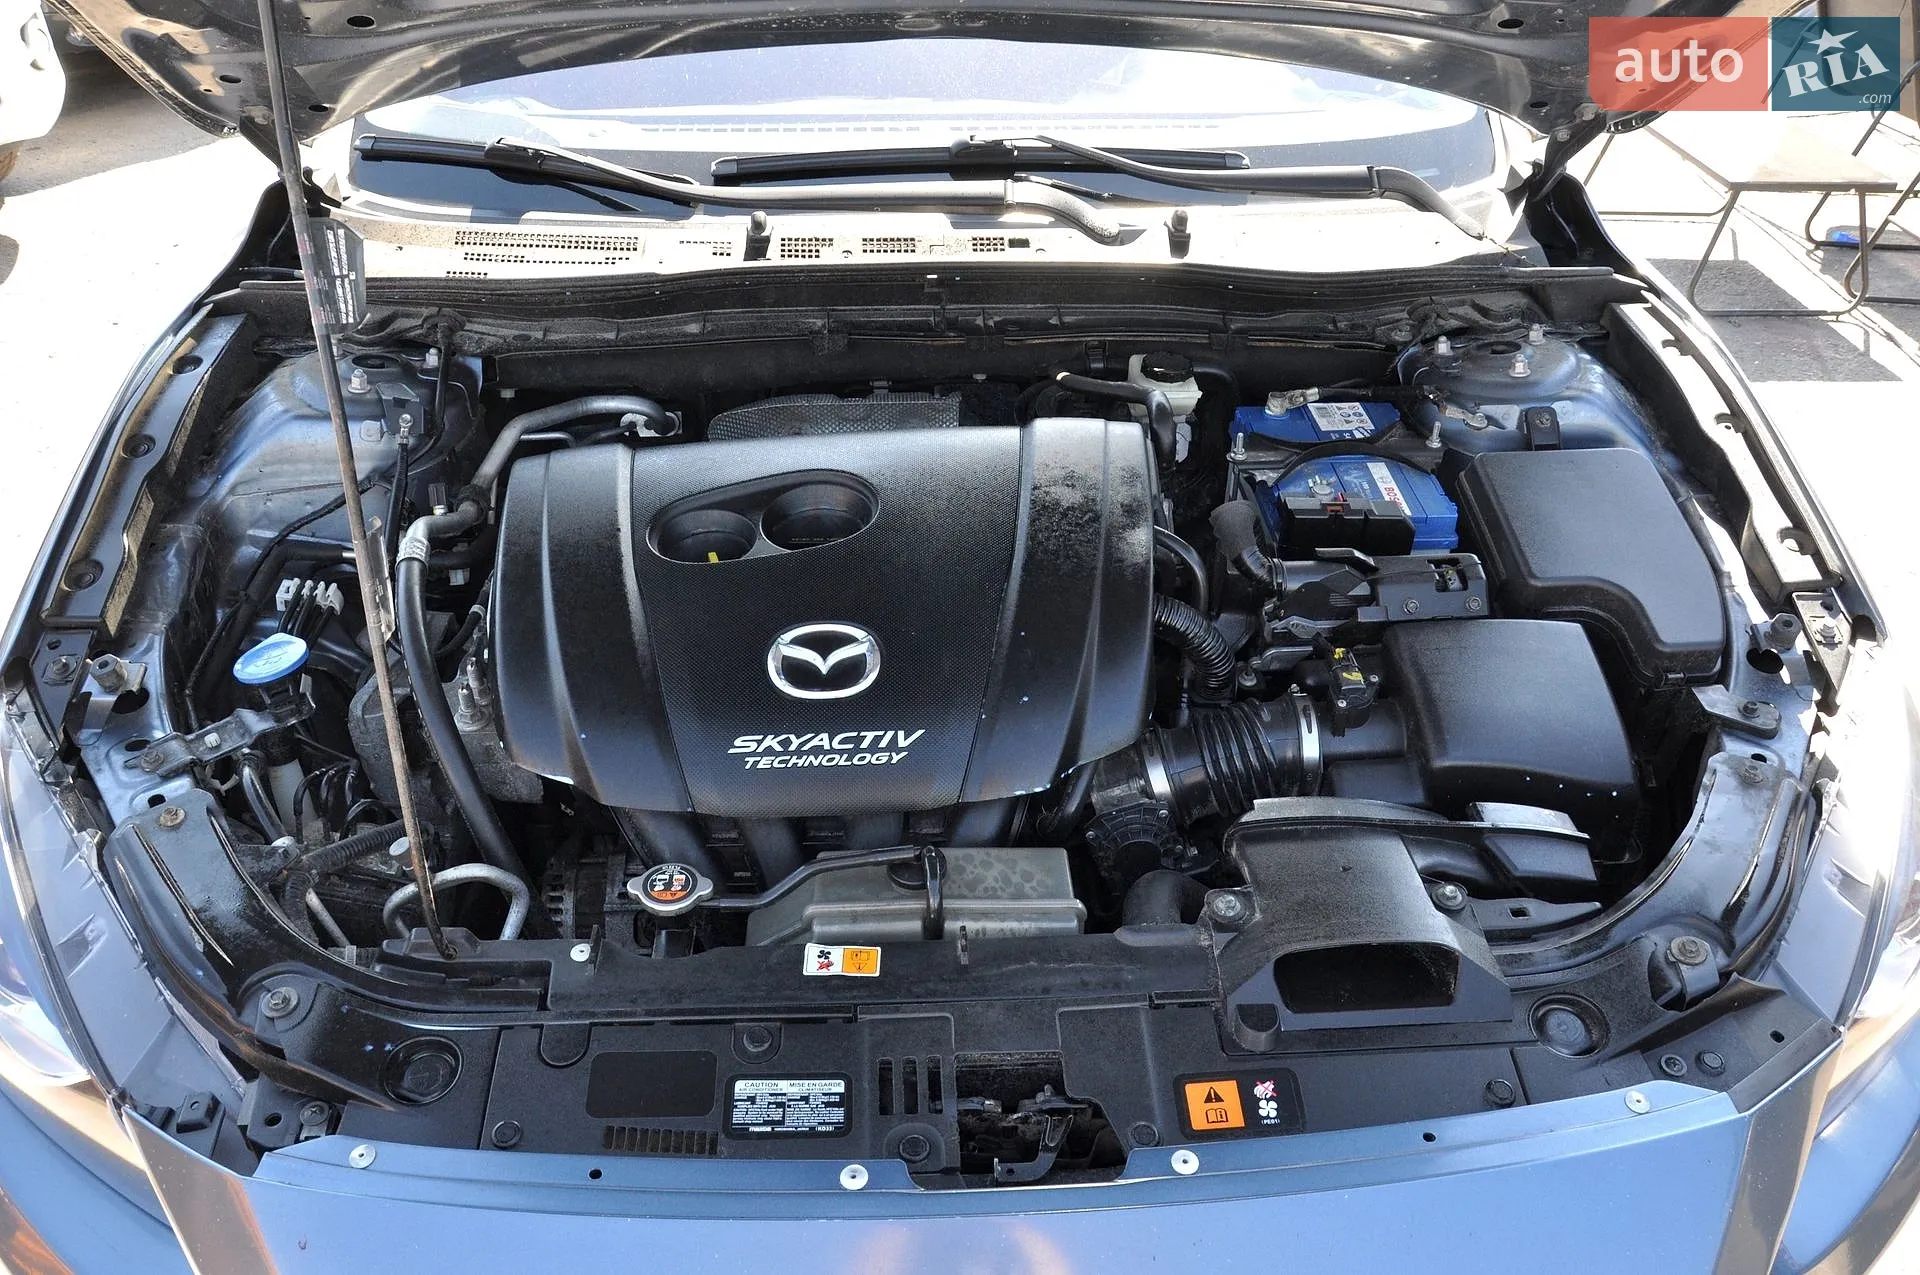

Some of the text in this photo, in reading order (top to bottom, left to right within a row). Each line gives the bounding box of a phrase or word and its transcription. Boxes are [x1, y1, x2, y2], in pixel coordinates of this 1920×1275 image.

[1384, 487, 1406, 511] BOS
[727, 729, 926, 754] SKYACTIV
[744, 751, 909, 770] TECHNOLOGY
